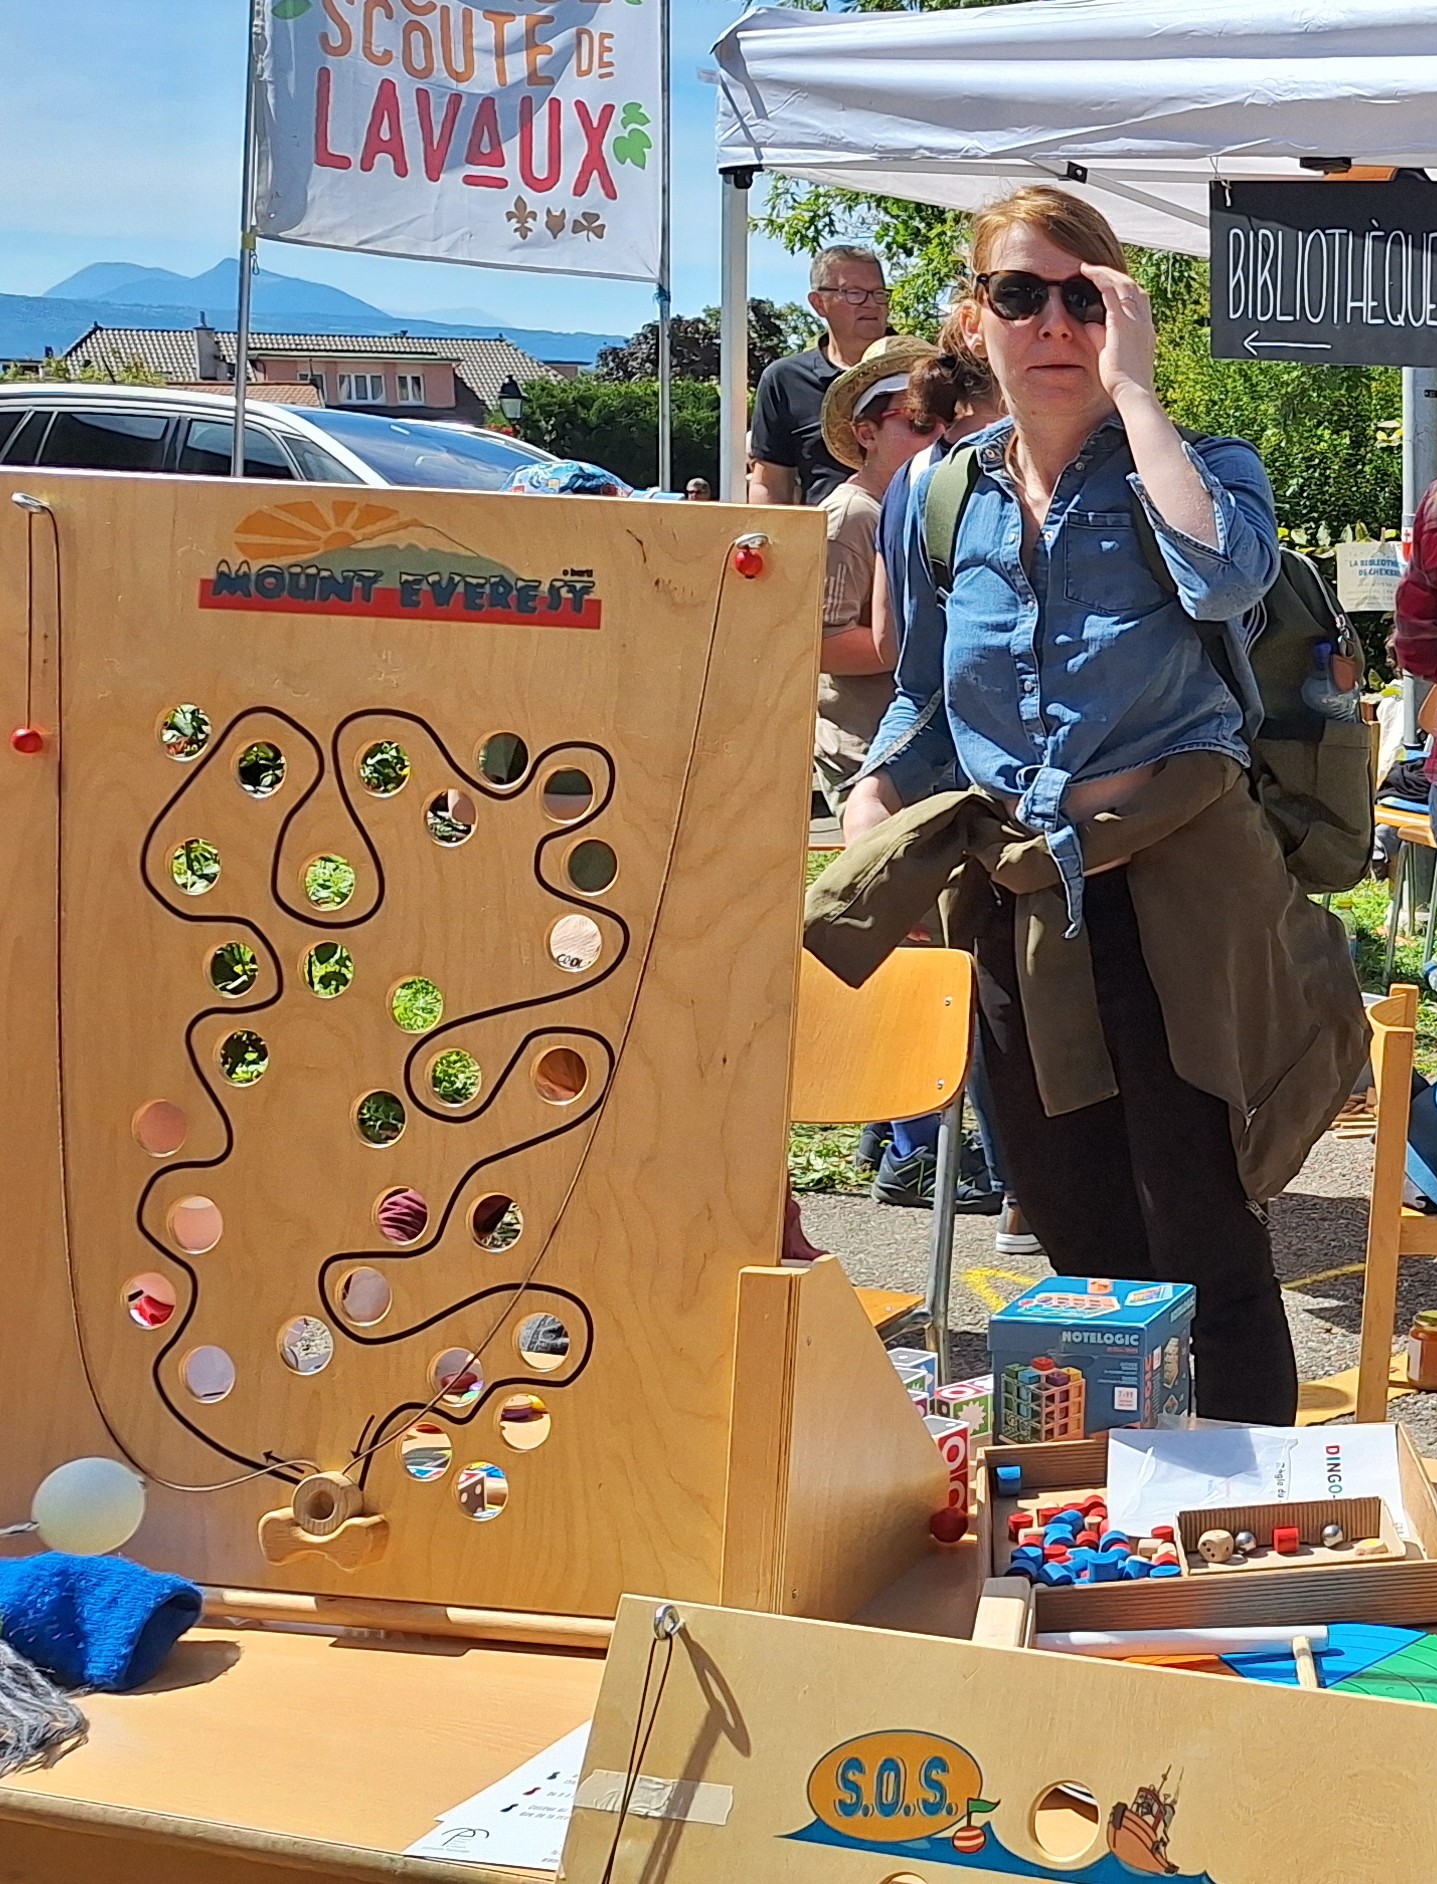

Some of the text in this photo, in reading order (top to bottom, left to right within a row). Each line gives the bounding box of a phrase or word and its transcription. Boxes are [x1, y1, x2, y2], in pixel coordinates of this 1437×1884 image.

[319, 0, 615, 87] SCOUTE DE
[313, 66, 618, 200] LAVAUX
[211, 559, 596, 614] MOUNT EVEREST
[1061, 1331, 1140, 1346] HOTELOGIC
[834, 1755, 959, 1818] S.O.S.
